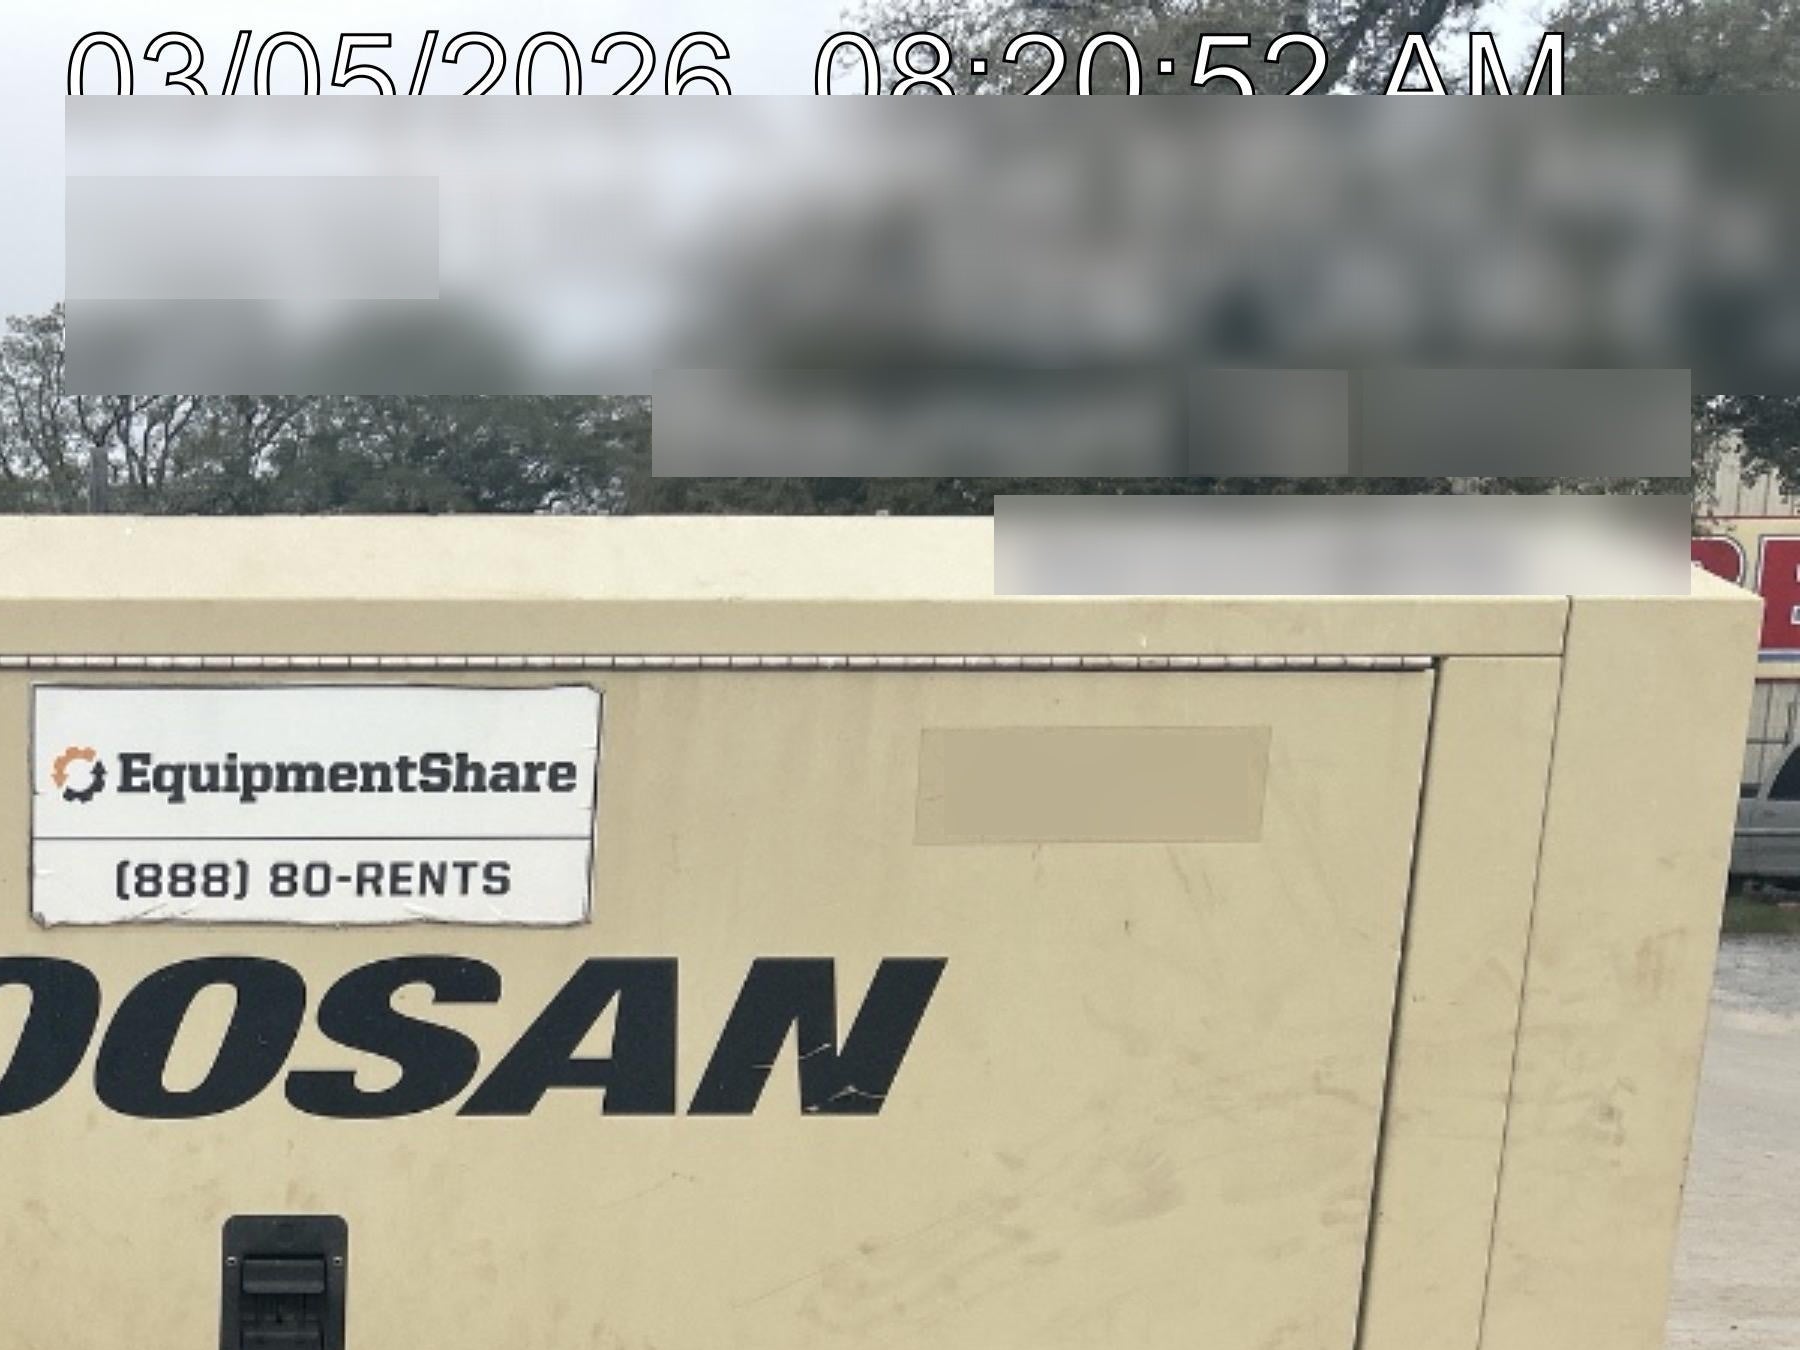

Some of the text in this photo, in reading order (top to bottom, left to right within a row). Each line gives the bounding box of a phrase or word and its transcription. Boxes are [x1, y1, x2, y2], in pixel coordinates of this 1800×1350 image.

[116, 752, 577, 803] EquipmentShare
[115, 860, 511, 900] (888) 80-RENTS
